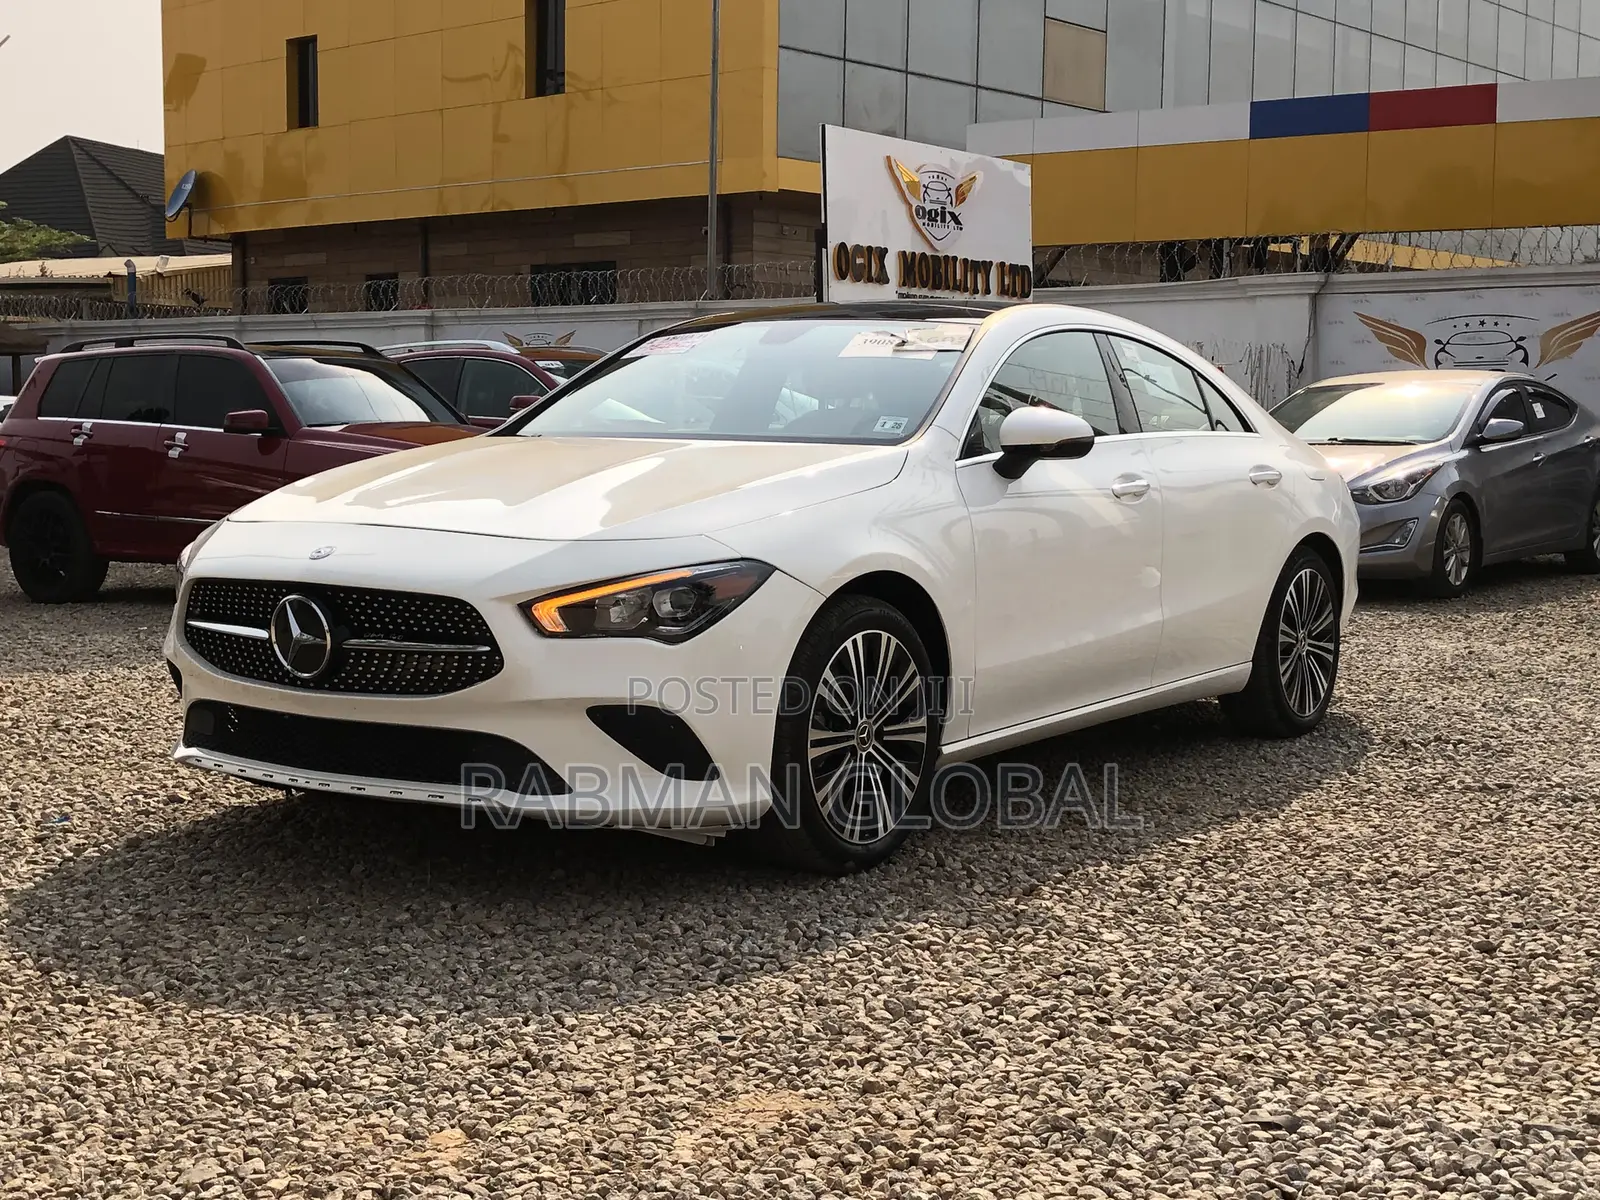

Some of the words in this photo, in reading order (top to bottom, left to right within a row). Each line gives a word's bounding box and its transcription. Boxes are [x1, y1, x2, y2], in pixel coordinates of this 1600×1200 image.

[833, 241, 890, 285] OGIX
[898, 250, 993, 296] MOBILITY
[995, 261, 1032, 299] LTD
